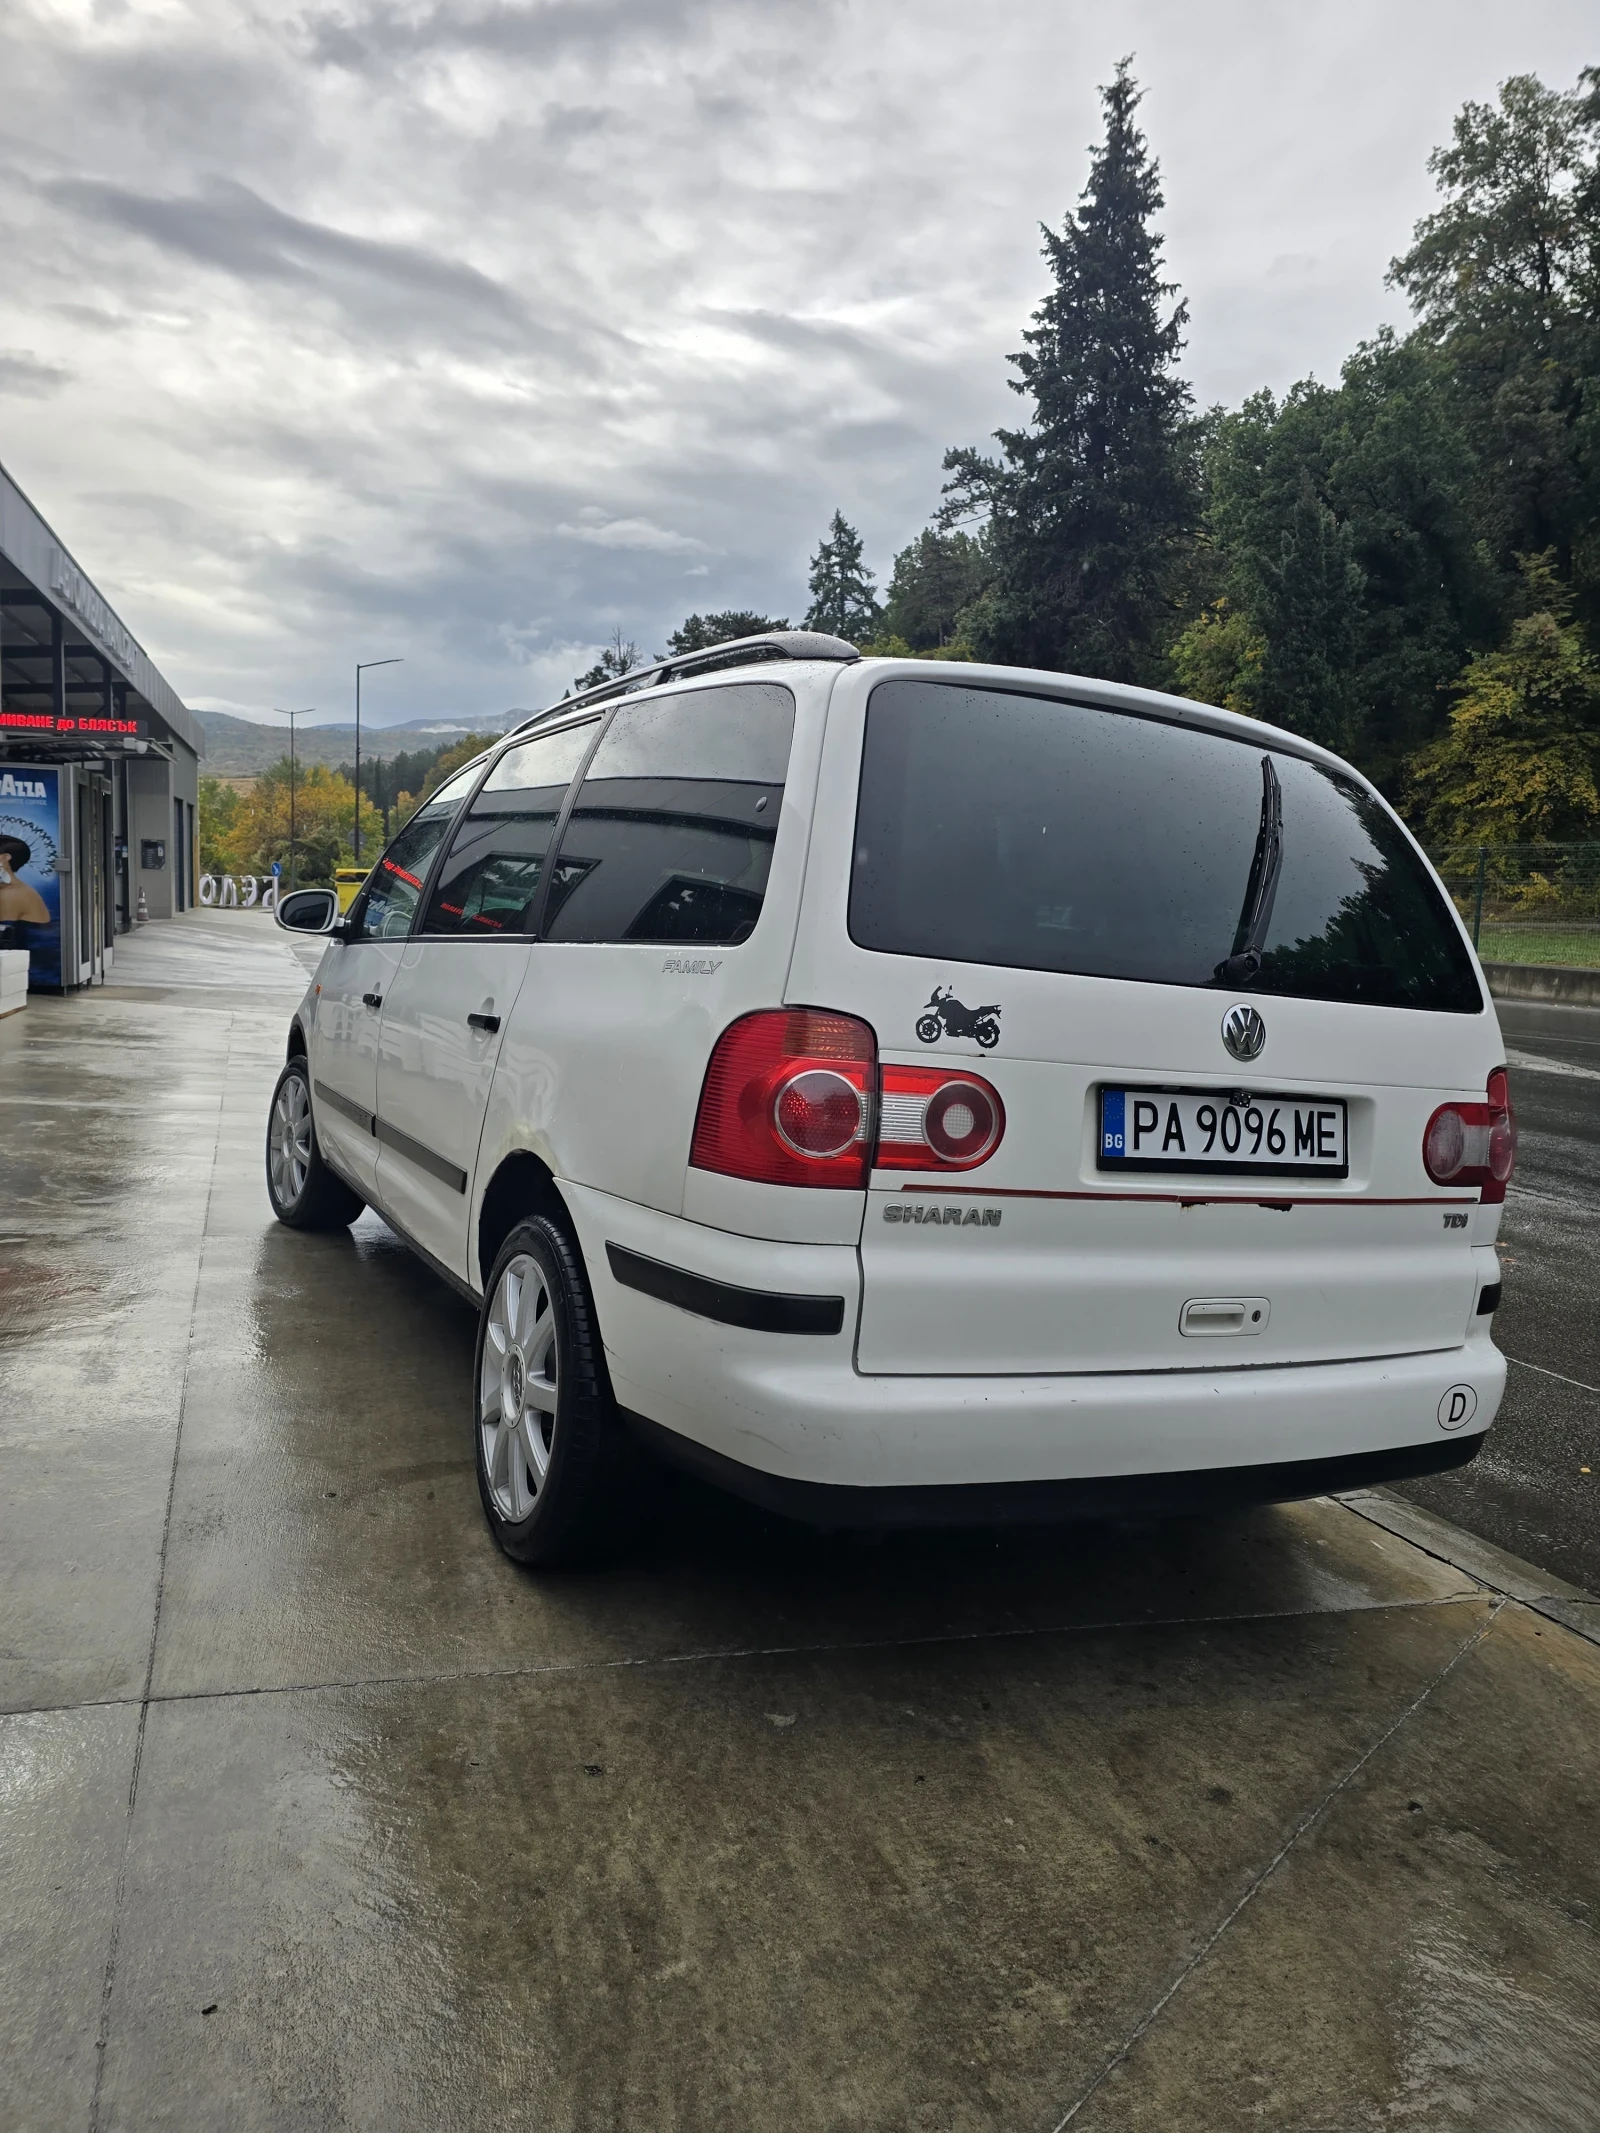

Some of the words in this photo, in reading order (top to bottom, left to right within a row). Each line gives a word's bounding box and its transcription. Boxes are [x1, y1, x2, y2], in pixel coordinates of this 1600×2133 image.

[57, 719, 75, 731] до
[79, 718, 137, 732] БЛЯСЪК
[0, 774, 47, 798] AZZA
[661, 960, 723, 975] FAMILY
[1105, 1133, 1123, 1149] BG
[883, 1203, 1002, 1227] SHARAN
[1443, 1213, 1468, 1229] TDI
[1447, 1392, 1466, 1423] D
